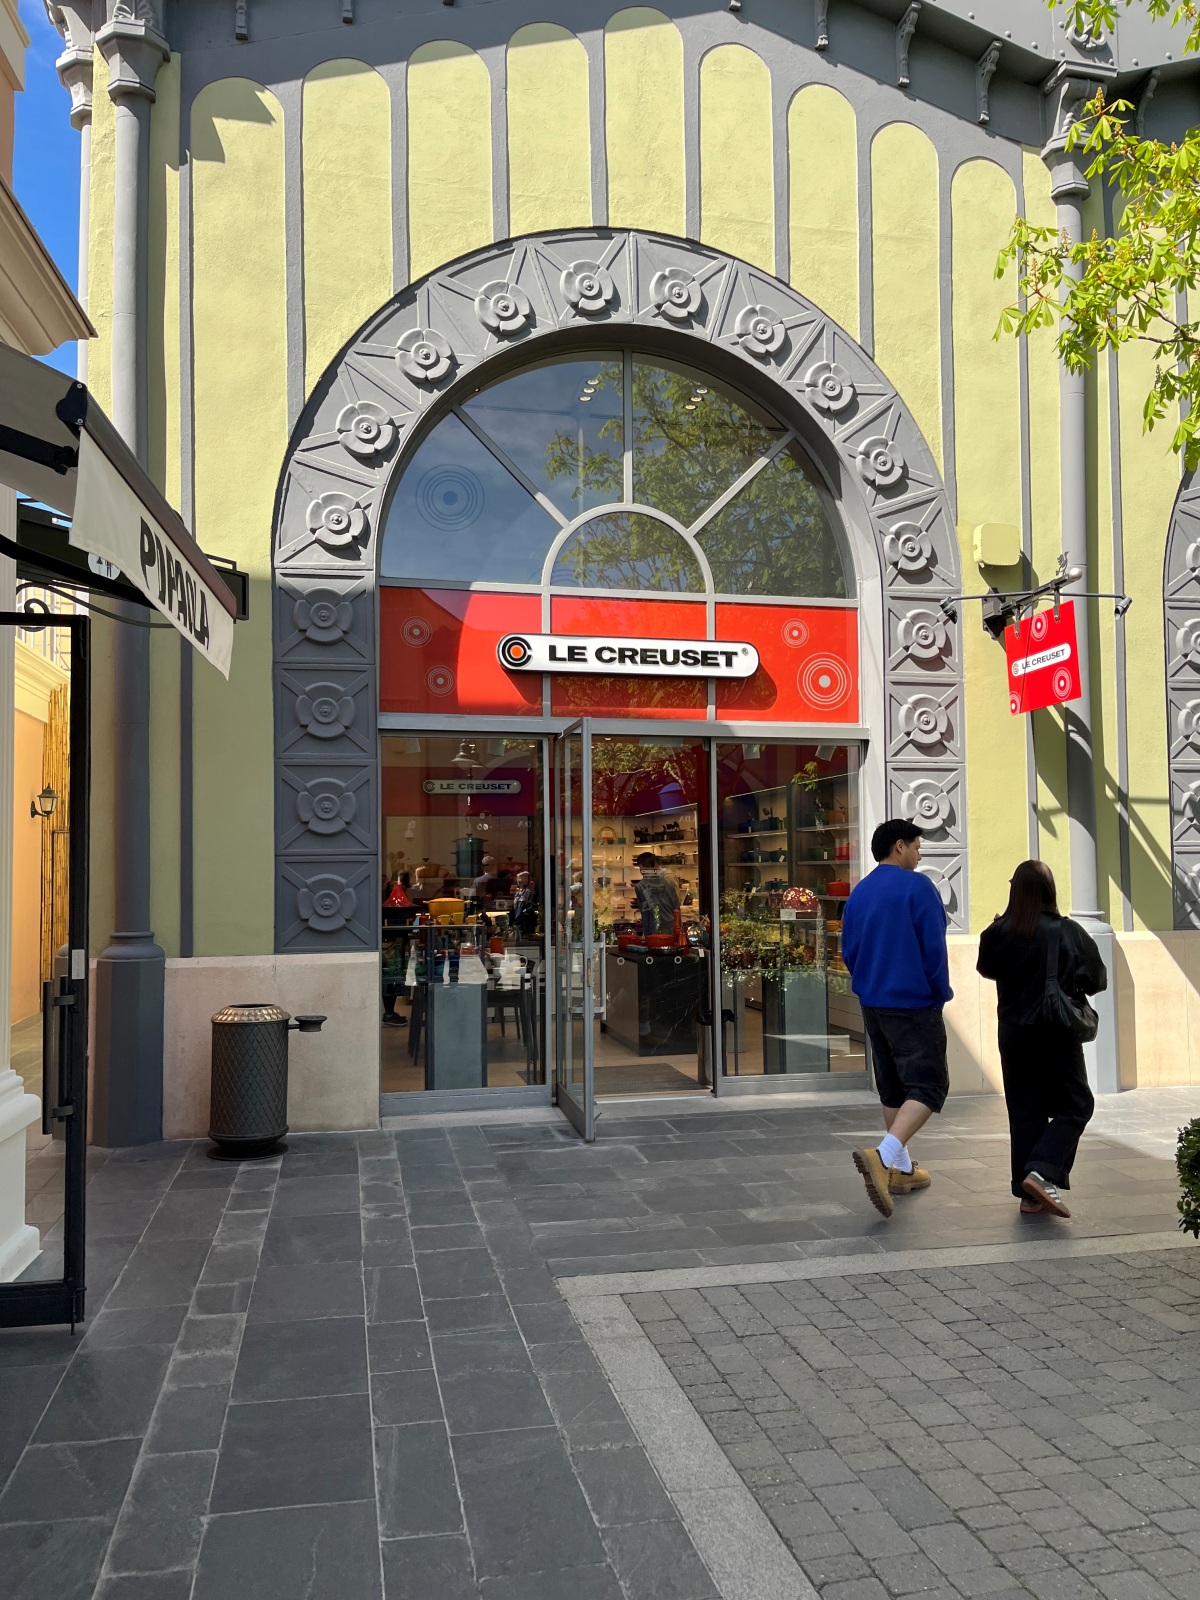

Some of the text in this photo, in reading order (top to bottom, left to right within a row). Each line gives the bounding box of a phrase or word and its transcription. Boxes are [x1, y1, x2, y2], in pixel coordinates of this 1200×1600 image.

[548, 644, 738, 668] LE CREUSET
[1021, 649, 1065, 669] LE CREUSET
